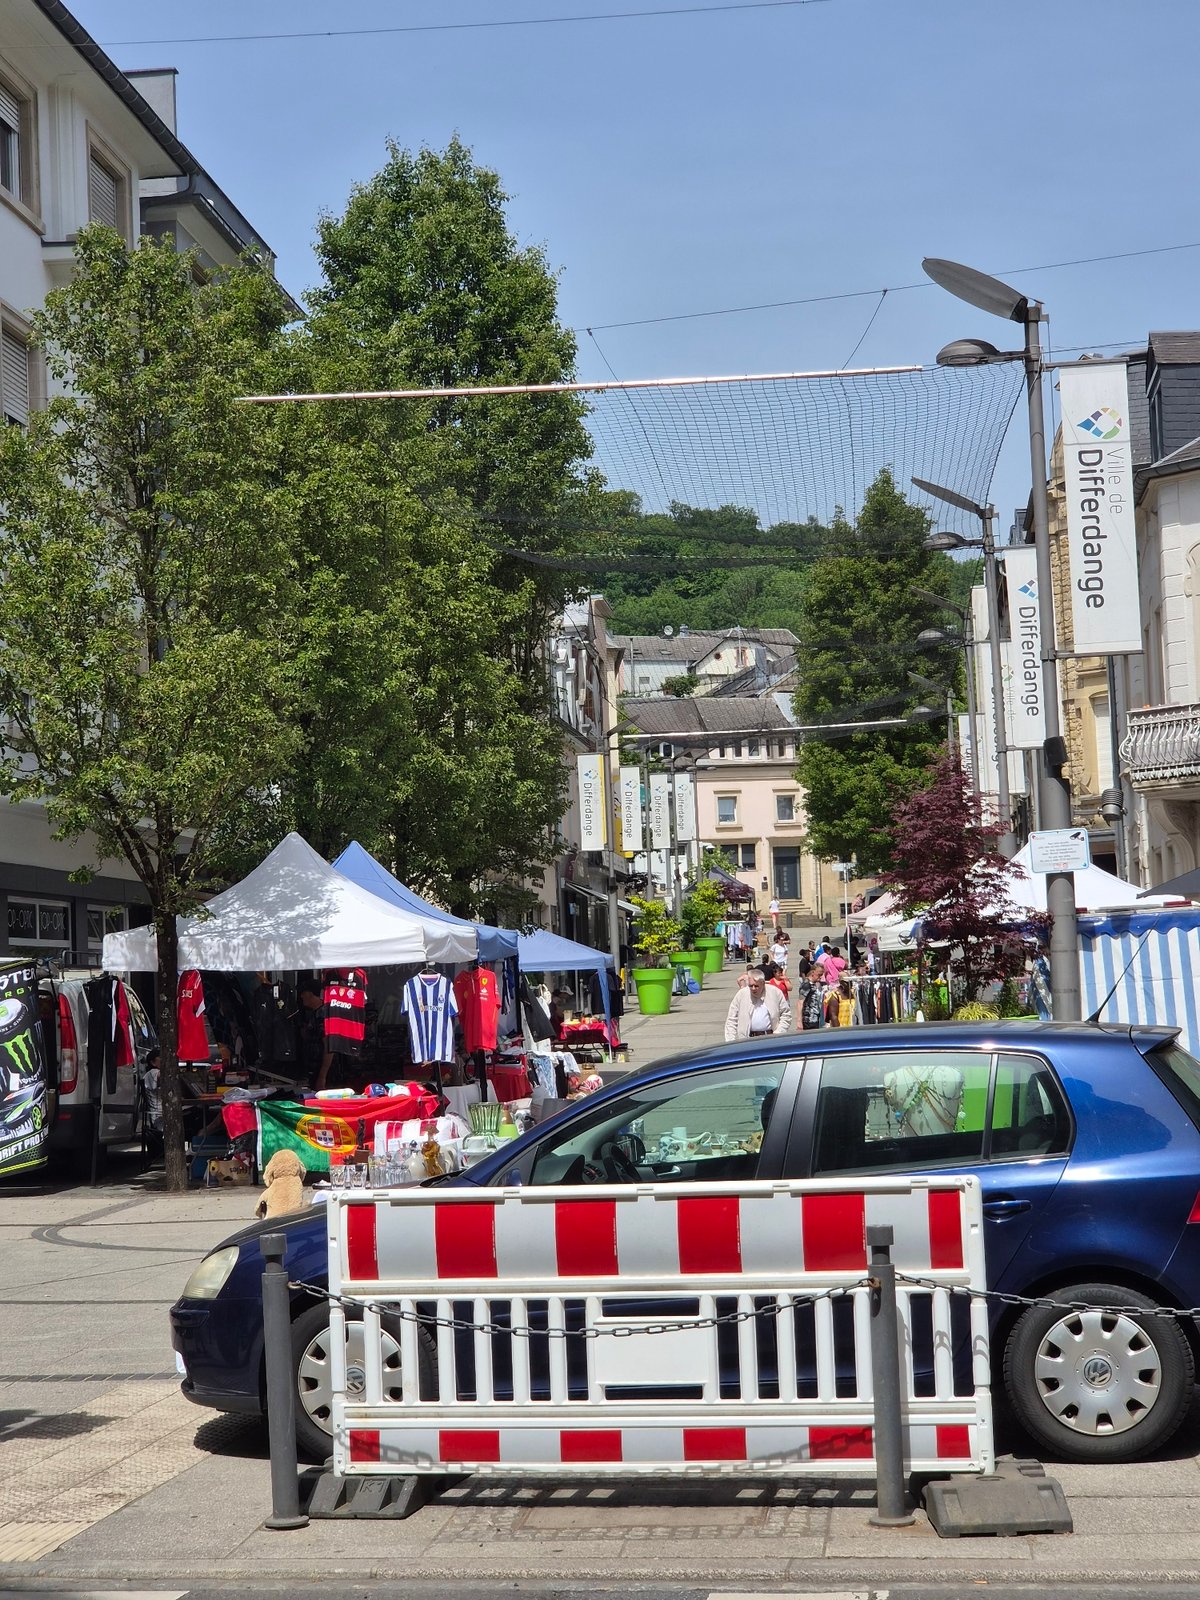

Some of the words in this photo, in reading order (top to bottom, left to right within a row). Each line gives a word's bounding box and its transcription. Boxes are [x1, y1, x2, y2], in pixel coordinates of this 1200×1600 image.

[1106, 447, 1125, 486] Ville
[1109, 493, 1126, 514] de
[1077, 448, 1108, 609] Differdange
[1018, 606, 1040, 717] Differdange
[583, 782, 593, 836] Differdange
[624, 791, 633, 839] Differdange
[654, 795, 662, 838] Differdange
[24, 1134, 40, 1150] PRO
